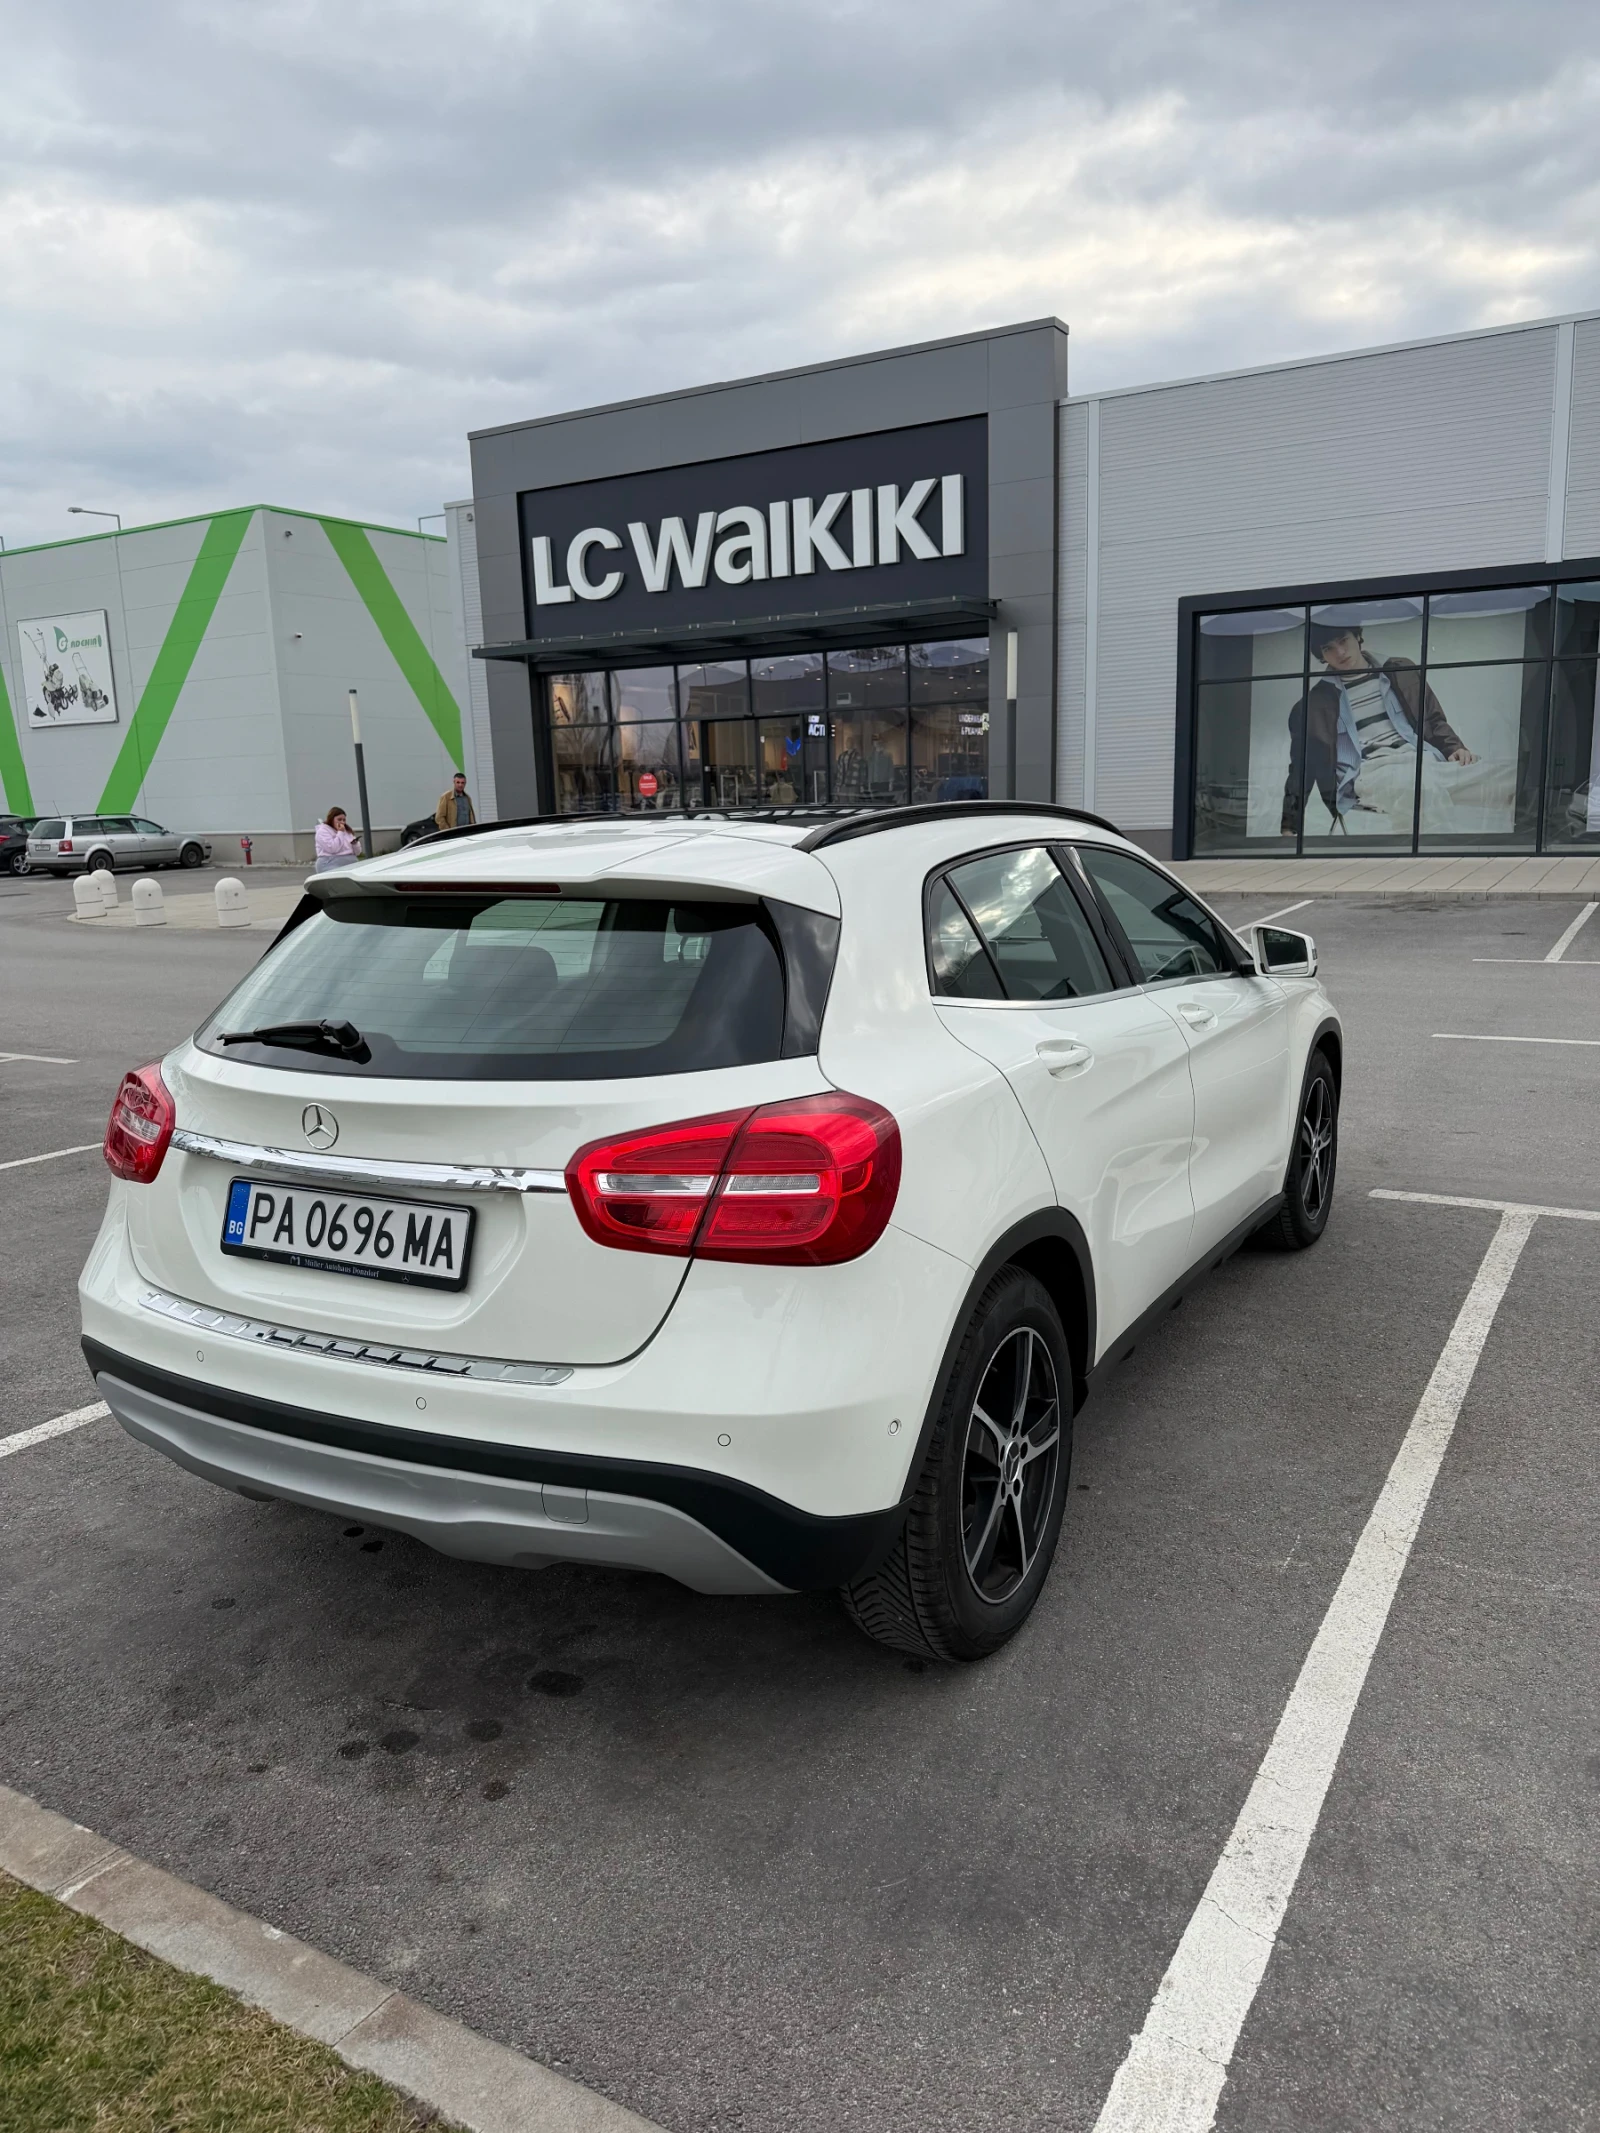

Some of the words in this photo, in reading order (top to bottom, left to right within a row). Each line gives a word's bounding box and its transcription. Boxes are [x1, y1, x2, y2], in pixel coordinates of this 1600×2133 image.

[532, 527, 624, 605] LC
[228, 1219, 243, 1235] BG
[250, 1192, 294, 1245] PA
[305, 1200, 395, 1259] 0696
[402, 1212, 454, 1270] MA
